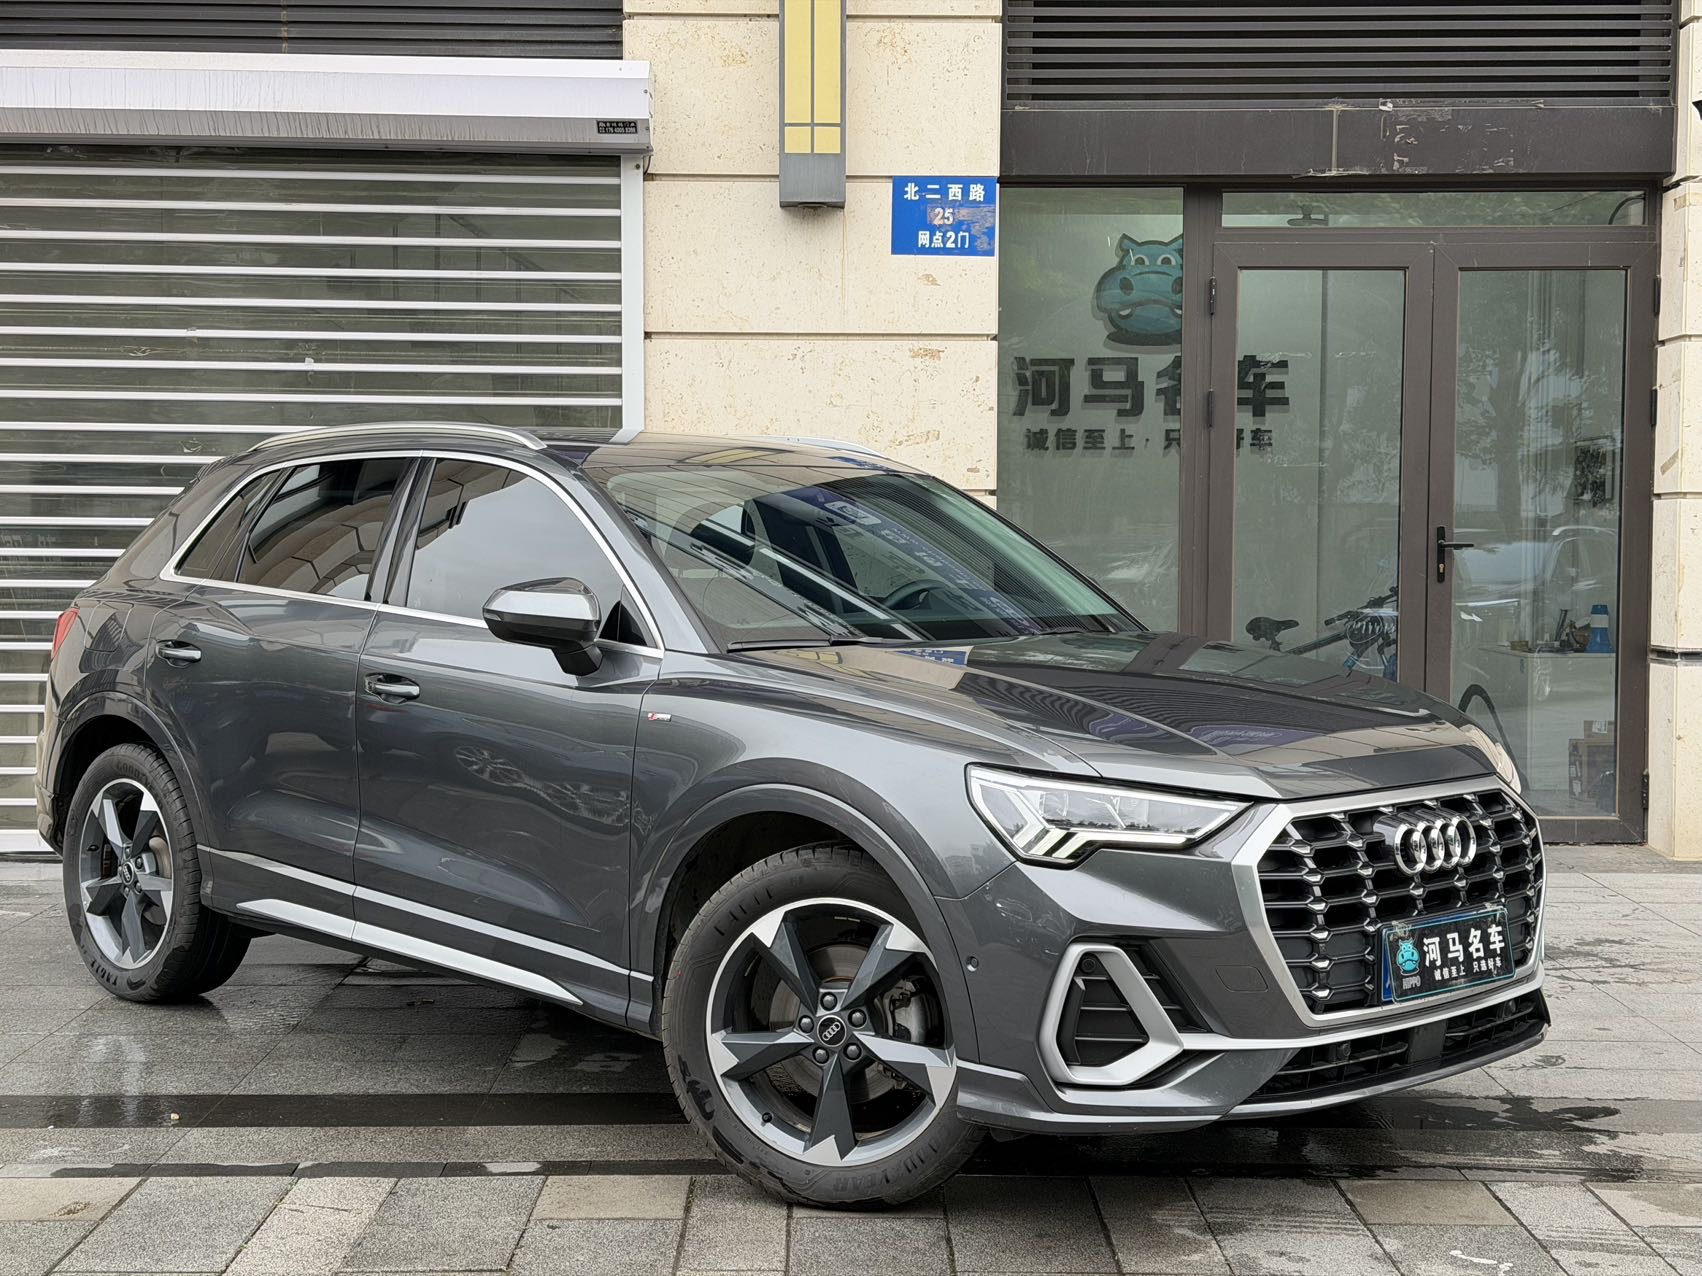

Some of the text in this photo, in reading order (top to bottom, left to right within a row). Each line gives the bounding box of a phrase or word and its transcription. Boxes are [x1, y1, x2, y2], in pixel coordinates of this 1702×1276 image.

[903, 182, 985, 202] 北二西路
[933, 207, 954, 225] 25
[918, 230, 969, 248] 网点2门
[1422, 923, 1505, 968] 河马名车
